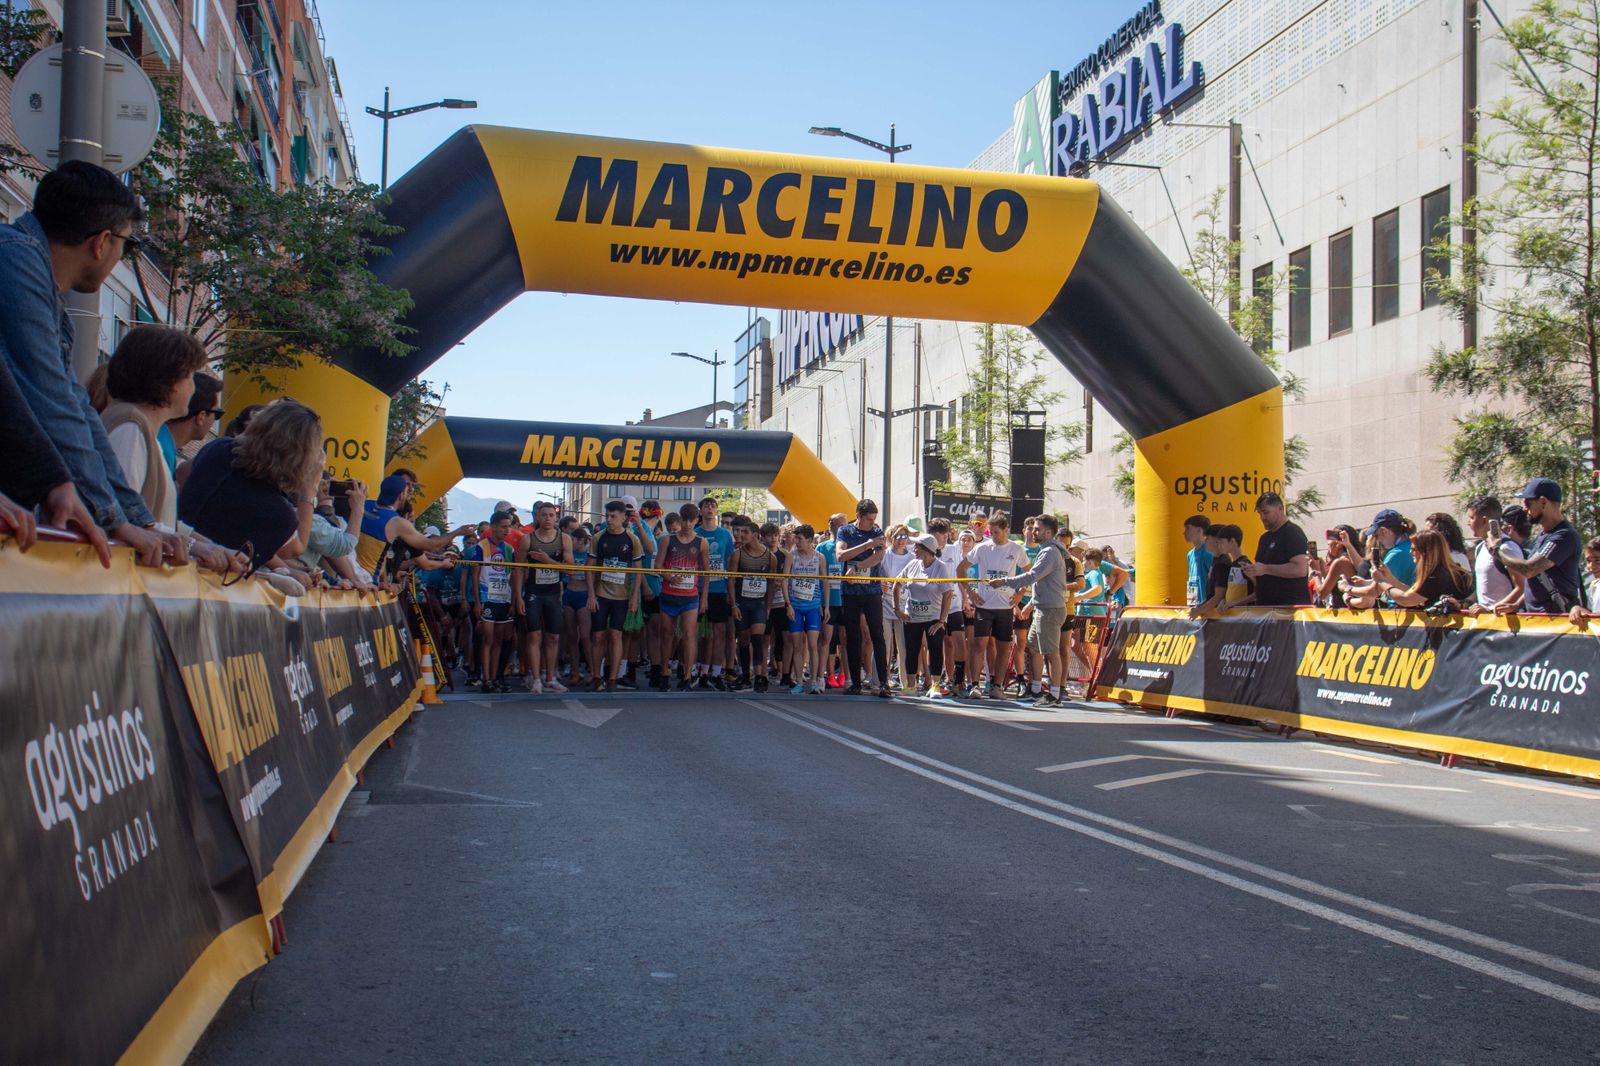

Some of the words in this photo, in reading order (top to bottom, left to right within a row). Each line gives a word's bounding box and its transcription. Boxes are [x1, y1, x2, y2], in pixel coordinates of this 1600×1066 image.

[1057, 52, 1095, 101] CENTRO
[1096, 0, 1162, 66] COMERCIAL
[555, 155, 1029, 254] MARCELINO
[610, 243, 974, 286] www.mpmarcelino.es
[773, 309, 864, 385] HIPER
[520, 434, 721, 472] MARCELINO
[542, 468, 696, 483] www.mpmarcelino.es
[1175, 470, 1285, 502] agustino
[1196, 502, 1258, 513] GRAN
[1118, 632, 1197, 666] MARCELINO
[1296, 640, 1436, 691] MARCELINO
[1480, 660, 1590, 695] agustinos
[1490, 694, 1560, 714] GRANADA
[24, 690, 155, 852] agustinos
[74, 811, 158, 901] GRANADA
